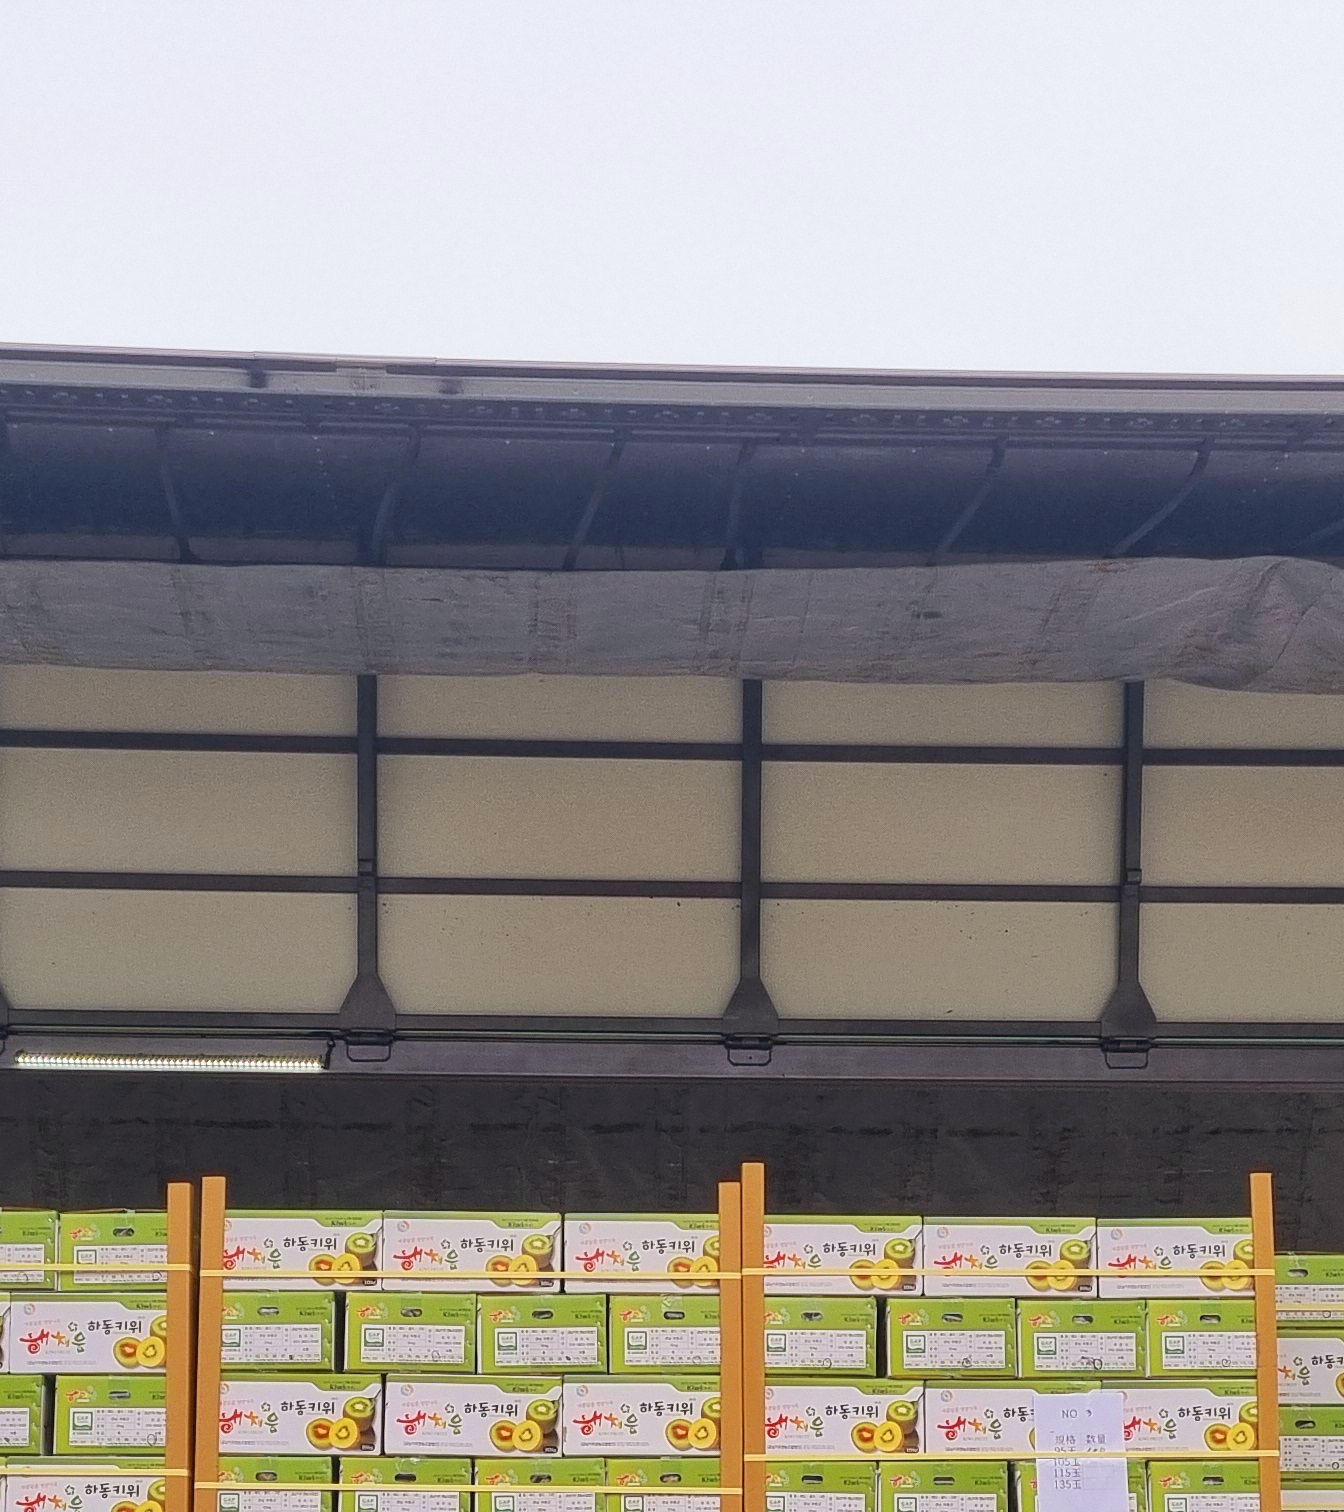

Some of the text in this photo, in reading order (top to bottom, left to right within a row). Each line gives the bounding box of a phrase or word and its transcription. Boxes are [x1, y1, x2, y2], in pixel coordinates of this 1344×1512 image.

[283, 1236, 337, 1252] 하동키위
[460, 1237, 514, 1253] 하동키위
[642, 1238, 695, 1255] 하동키위
[823, 1241, 876, 1257] 하동키위
[999, 1242, 1052, 1259] 하동키위
[1173, 1243, 1226, 1259] 하동키위
[88, 1319, 142, 1335] 하동키위
[281, 1399, 335, 1416] 하동키위
[464, 1402, 518, 1418] 하동키위
[640, 1401, 693, 1417] 하동키위
[825, 1404, 879, 1420] 하동키위
[1003, 1406, 1035, 1422] 하동
[1061, 1409, 1078, 1419] NO
[1178, 1405, 1231, 1422] 하동키위
[85, 1482, 140, 1499] 하동키위
